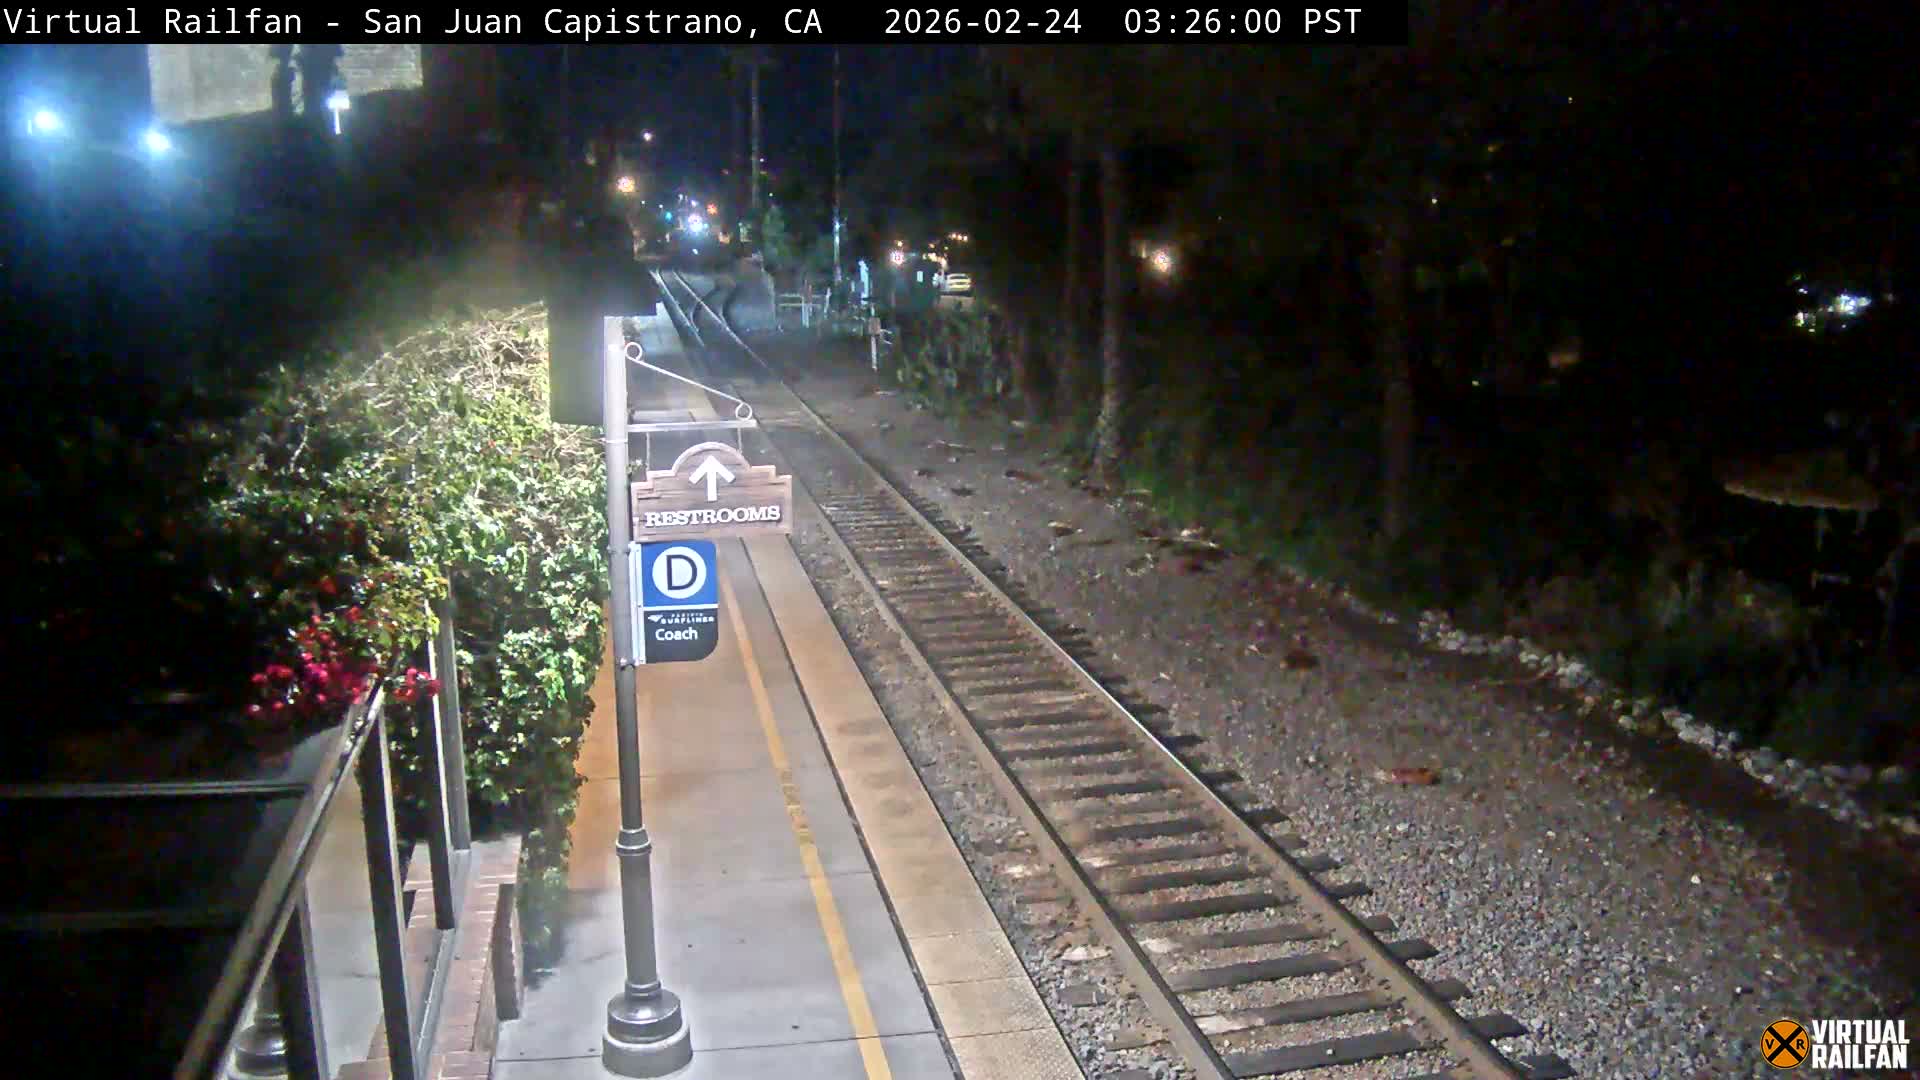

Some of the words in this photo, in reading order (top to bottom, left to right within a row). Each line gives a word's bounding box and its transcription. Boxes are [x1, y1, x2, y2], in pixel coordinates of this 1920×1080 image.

[644, 505, 780, 527] RESTROOMS
[666, 554, 697, 590] D
[655, 626, 698, 641] Coach
